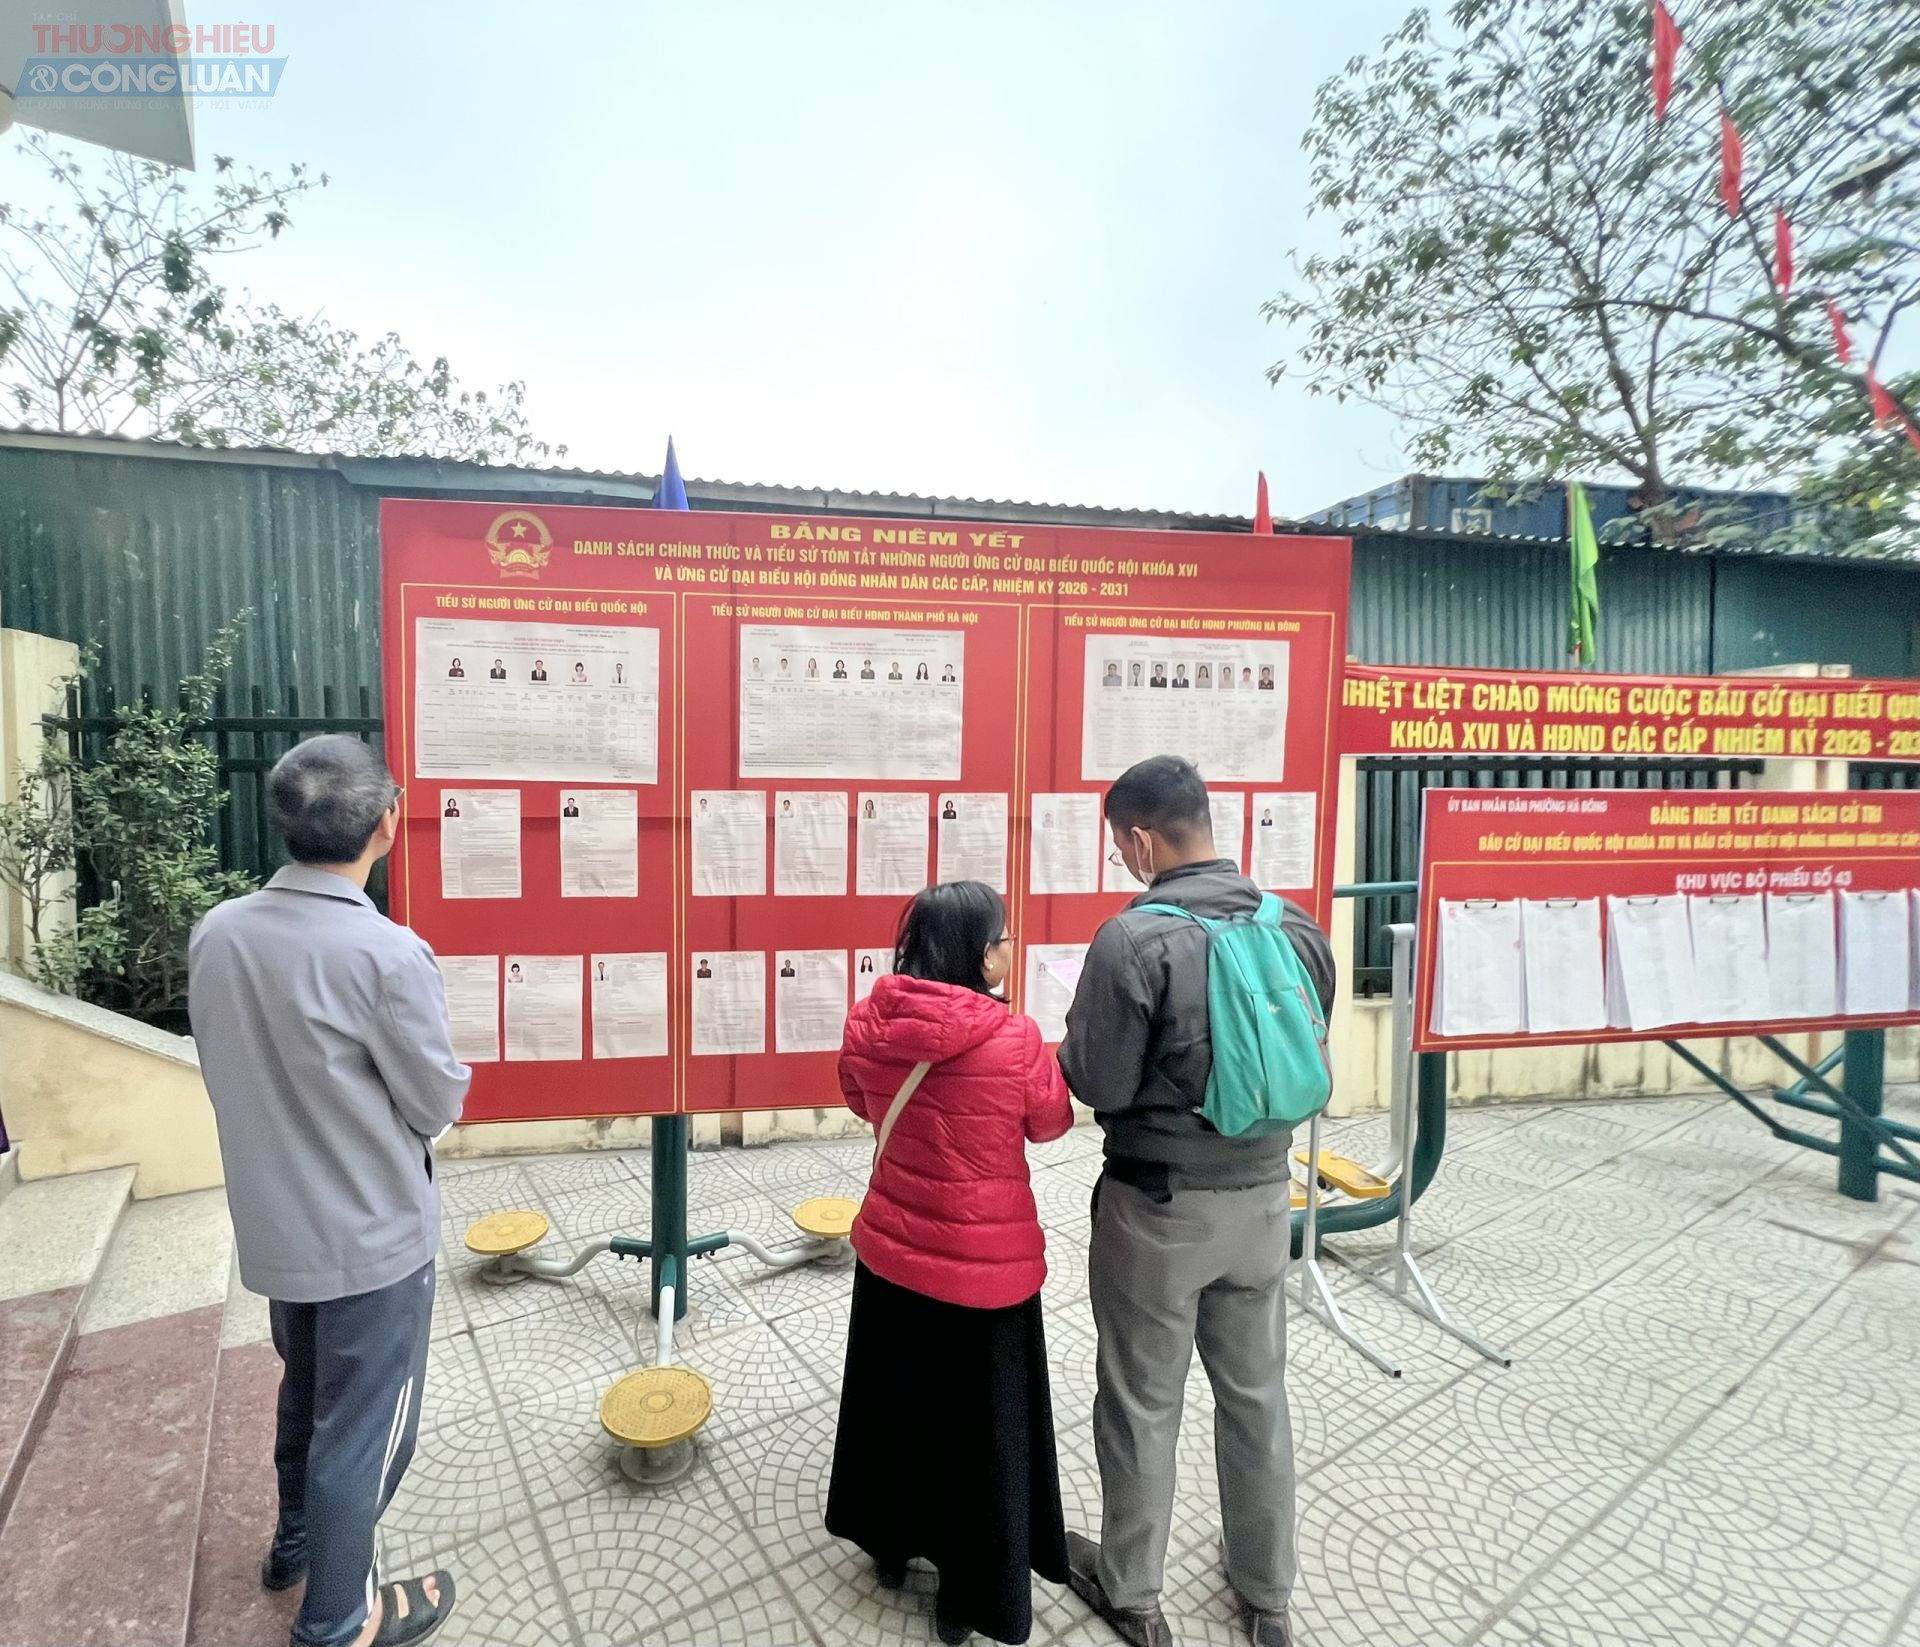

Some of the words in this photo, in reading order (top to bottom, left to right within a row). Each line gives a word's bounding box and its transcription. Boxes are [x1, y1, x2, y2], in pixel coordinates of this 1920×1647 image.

[770, 521, 861, 542] BẢNG
[873, 527, 958, 546] NIÊM
[969, 530, 1024, 549] YẾT
[574, 540, 613, 556] DANH
[617, 541, 655, 557] SÁCH
[658, 541, 701, 559] CHÍNH
[705, 543, 740, 560] THỨC
[744, 545, 762, 561] VÀ
[766, 543, 795, 562] TIỂU
[799, 544, 819, 563] SỬ
[821, 547, 849, 564] TÓM
[853, 545, 876, 565] TẮT
[880, 550, 926, 567] NHỮNG
[930, 552, 969, 569] NGƯỜI
[973, 552, 1000, 571] ỨNG
[1003, 552, 1022, 571] CỬ
[1024, 557, 1045, 574] ĐẠI
[1049, 553, 1077, 573] BIỂU
[1081, 555, 1114, 575] QUỐC
[1118, 559, 1138, 578] HỘI
[1142, 559, 1175, 576] KHÓA
[1178, 563, 1198, 577] XVI
[654, 563, 672, 581] VÀ
[676, 565, 705, 582] ỨNG
[710, 563, 729, 583] CỬ
[732, 569, 754, 586] ĐẠI
[759, 565, 790, 585] BIỂU
[794, 570, 816, 588] HỘI
[820, 570, 857, 587] ĐỒNG
[860, 572, 897, 589] NHÂN
[901, 573, 928, 590] DÂN
[932, 573, 958, 590] CÁC
[962, 572, 989, 593] CẤP,
[993, 577, 1034, 596] NHIỆM
[1038, 578, 1054, 594] KỲ
[1058, 581, 1088, 595] 2026
[1100, 582, 1129, 597] 2031
[435, 593, 459, 608] TIỂU
[461, 594, 478, 609] SỬ
[479, 596, 511, 610] NGƯỜI
[513, 596, 535, 611] ỨNG
[538, 596, 554, 612] CỬ
[555, 599, 572, 614] ĐẠI
[575, 598, 598, 613] BIỂU
[600, 599, 627, 614] QUỐC
[630, 601, 648, 616] HỘI
[711, 602, 733, 617] TIỂU
[735, 603, 751, 617] SỬ
[752, 605, 782, 618] NGƯỜI
[784, 605, 804, 619] ỨNG
[806, 605, 822, 619] CỬ
[822, 608, 838, 622] ĐẠI
[840, 606, 862, 621] BIỂU
[865, 610, 890, 622] HĐND
[893, 609, 924, 623] THÀNH
[926, 608, 945, 623] PHỐ
[947, 610, 961, 624] HÀ
[962, 611, 979, 625] NỘI
[1064, 613, 1083, 627] TIỂU
[1085, 614, 1100, 627] SỬ
[1100, 616, 1127, 628] NGƯỜI
[1129, 615, 1148, 628] ỨNG
[1149, 616, 1165, 629] CỬ
[1164, 619, 1179, 632] ĐẠI
[1181, 616, 1200, 630] BIỂU
[1228, 619, 1262, 632] PHƯỜNG
[1264, 620, 1276, 632] HÀ
[1343, 675, 1407, 714] HIỆT
[1413, 677, 1466, 716] LIỆT
[1472, 679, 1540, 713] CHÀO
[1547, 681, 1622, 715] MỪNG
[1627, 683, 1692, 721] CUỘC
[1698, 682, 1747, 717] BẦU
[1752, 682, 1789, 718] CỬ
[1788, 691, 1828, 723] ĐẠI
[1832, 683, 1883, 719] BIỂU
[1390, 716, 1454, 749] KHÓA
[1460, 722, 1499, 750] XVI
[1506, 719, 1537, 751] VÀ
[1542, 724, 1606, 752] HĐND
[1612, 720, 1657, 753] CÁC
[1663, 718, 1708, 753] CẤP
[1823, 729, 1872, 755] 2026
[1651, 800, 1690, 825] BẢNG
[1694, 803, 1731, 825] NIÊM
[1735, 801, 1759, 824] YẾT
[1761, 805, 1799, 824] DANH
[1801, 802, 1837, 824] SÁCH
[1676, 874, 1707, 889] KHU
[1711, 872, 1742, 892] VỰC
[1745, 867, 1767, 889] BỎ
[1770, 865, 1809, 888] PHIẾU
[1812, 865, 1833, 887] SỐ
